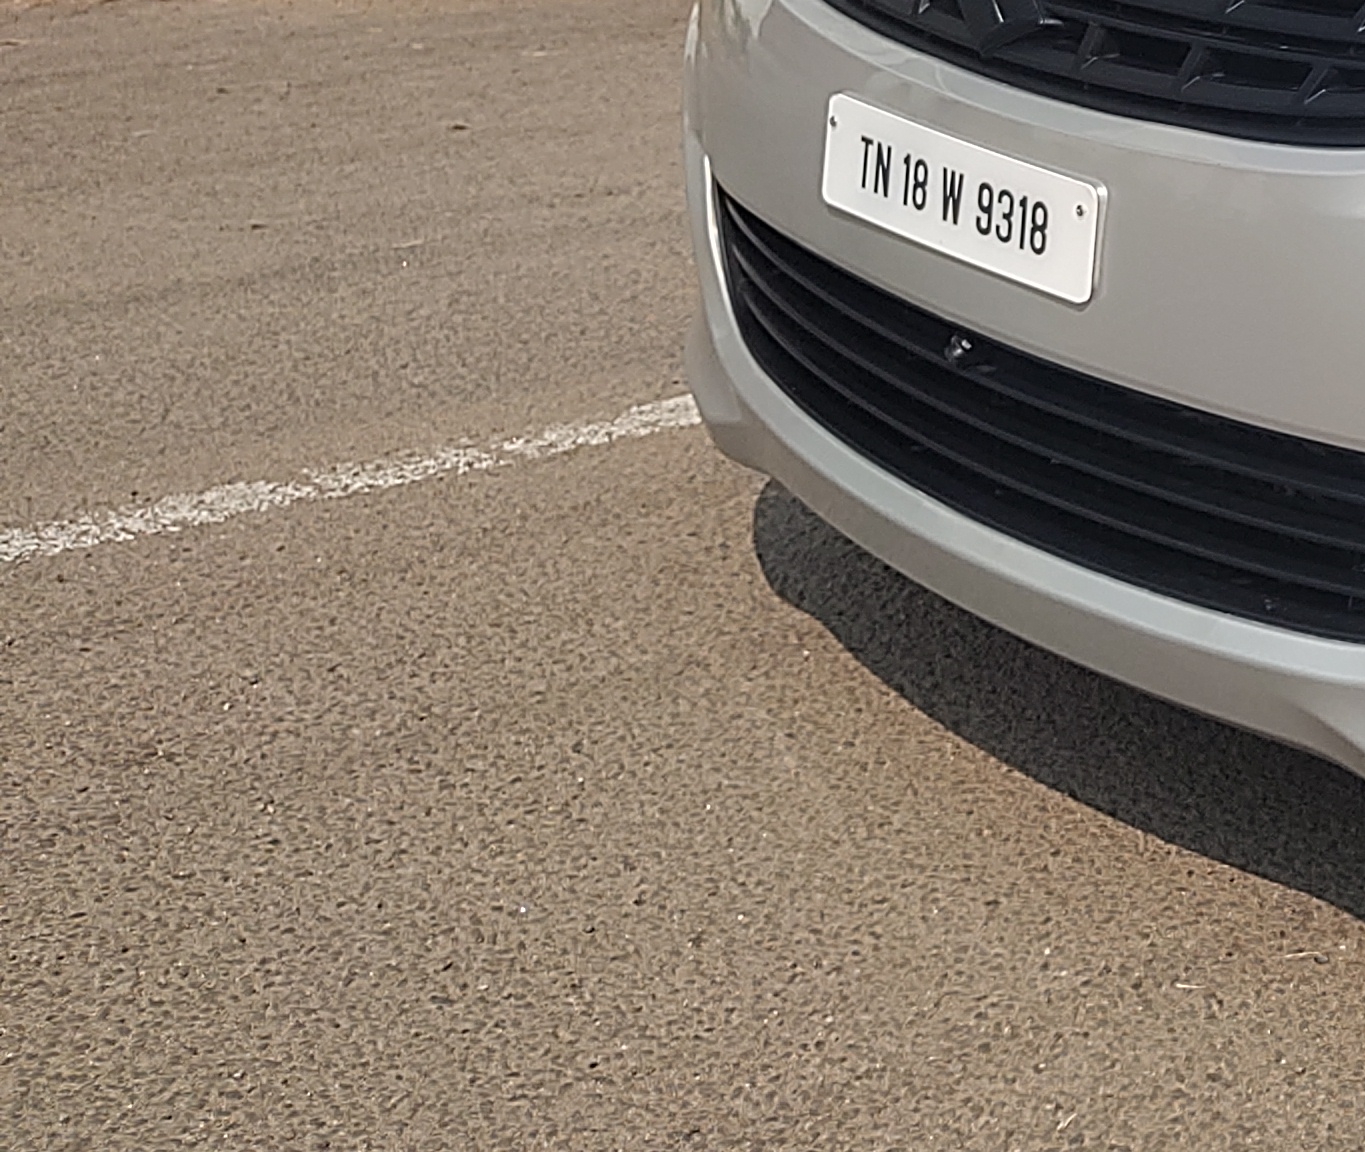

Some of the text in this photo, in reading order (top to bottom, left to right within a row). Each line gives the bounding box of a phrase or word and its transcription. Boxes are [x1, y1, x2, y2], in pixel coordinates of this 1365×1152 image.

[860, 135, 1048, 256] TN 18 W 9318
